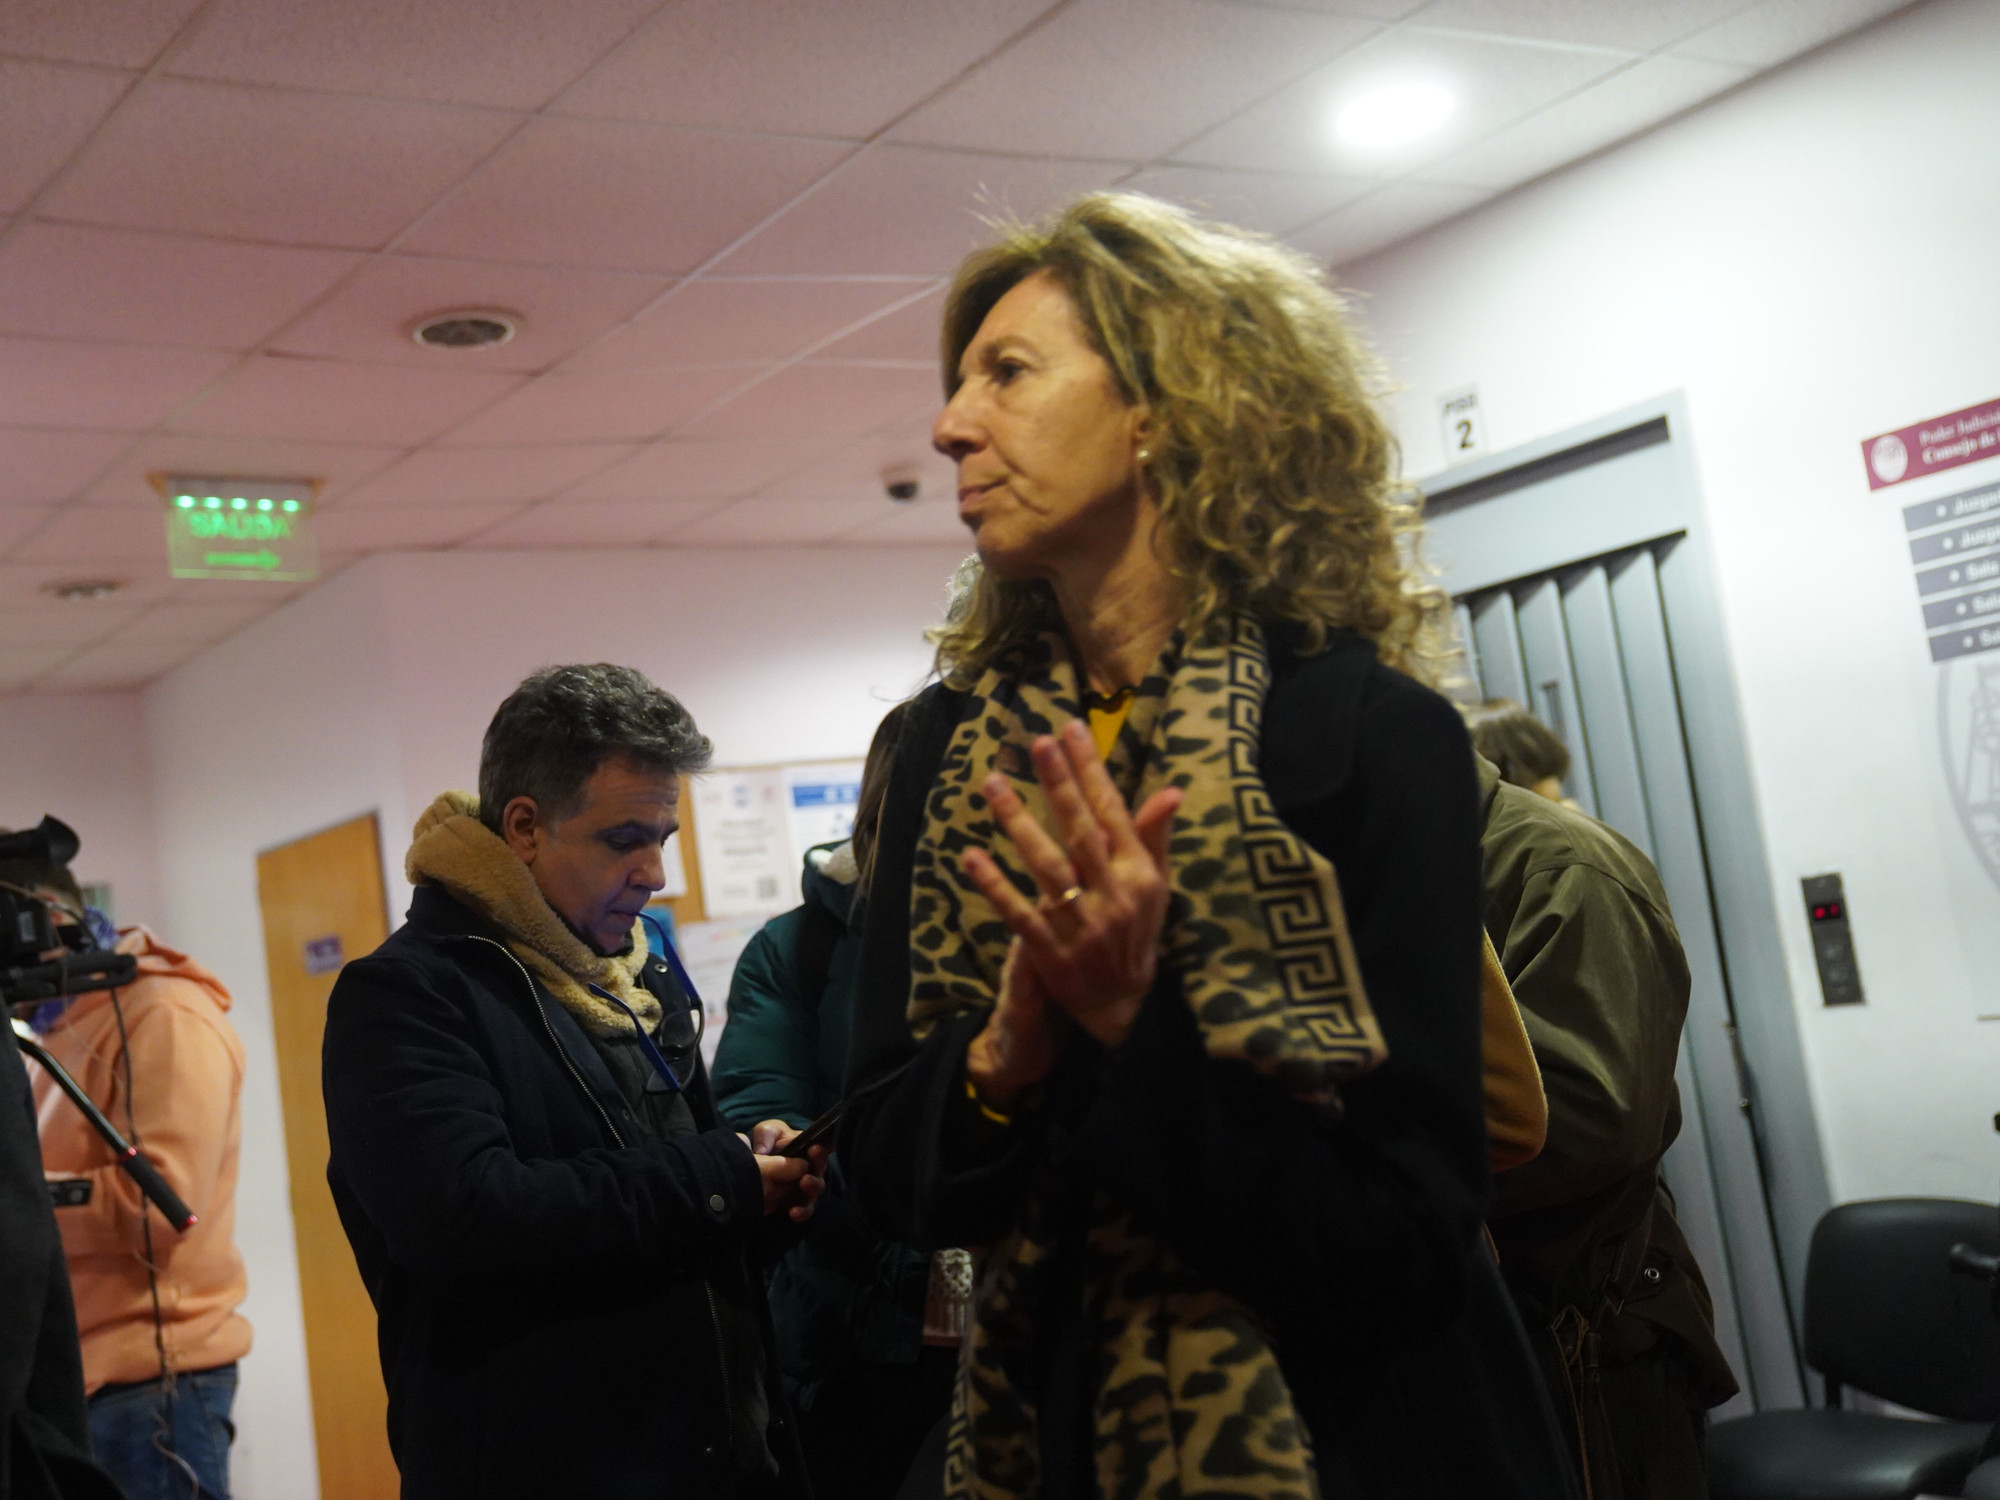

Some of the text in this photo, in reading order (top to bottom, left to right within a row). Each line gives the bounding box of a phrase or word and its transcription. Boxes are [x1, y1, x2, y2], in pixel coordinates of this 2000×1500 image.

[1456, 419, 1475, 450] 2
[1922, 437, 1977, 464] Consejo
[1979, 430, 1996, 449] de
